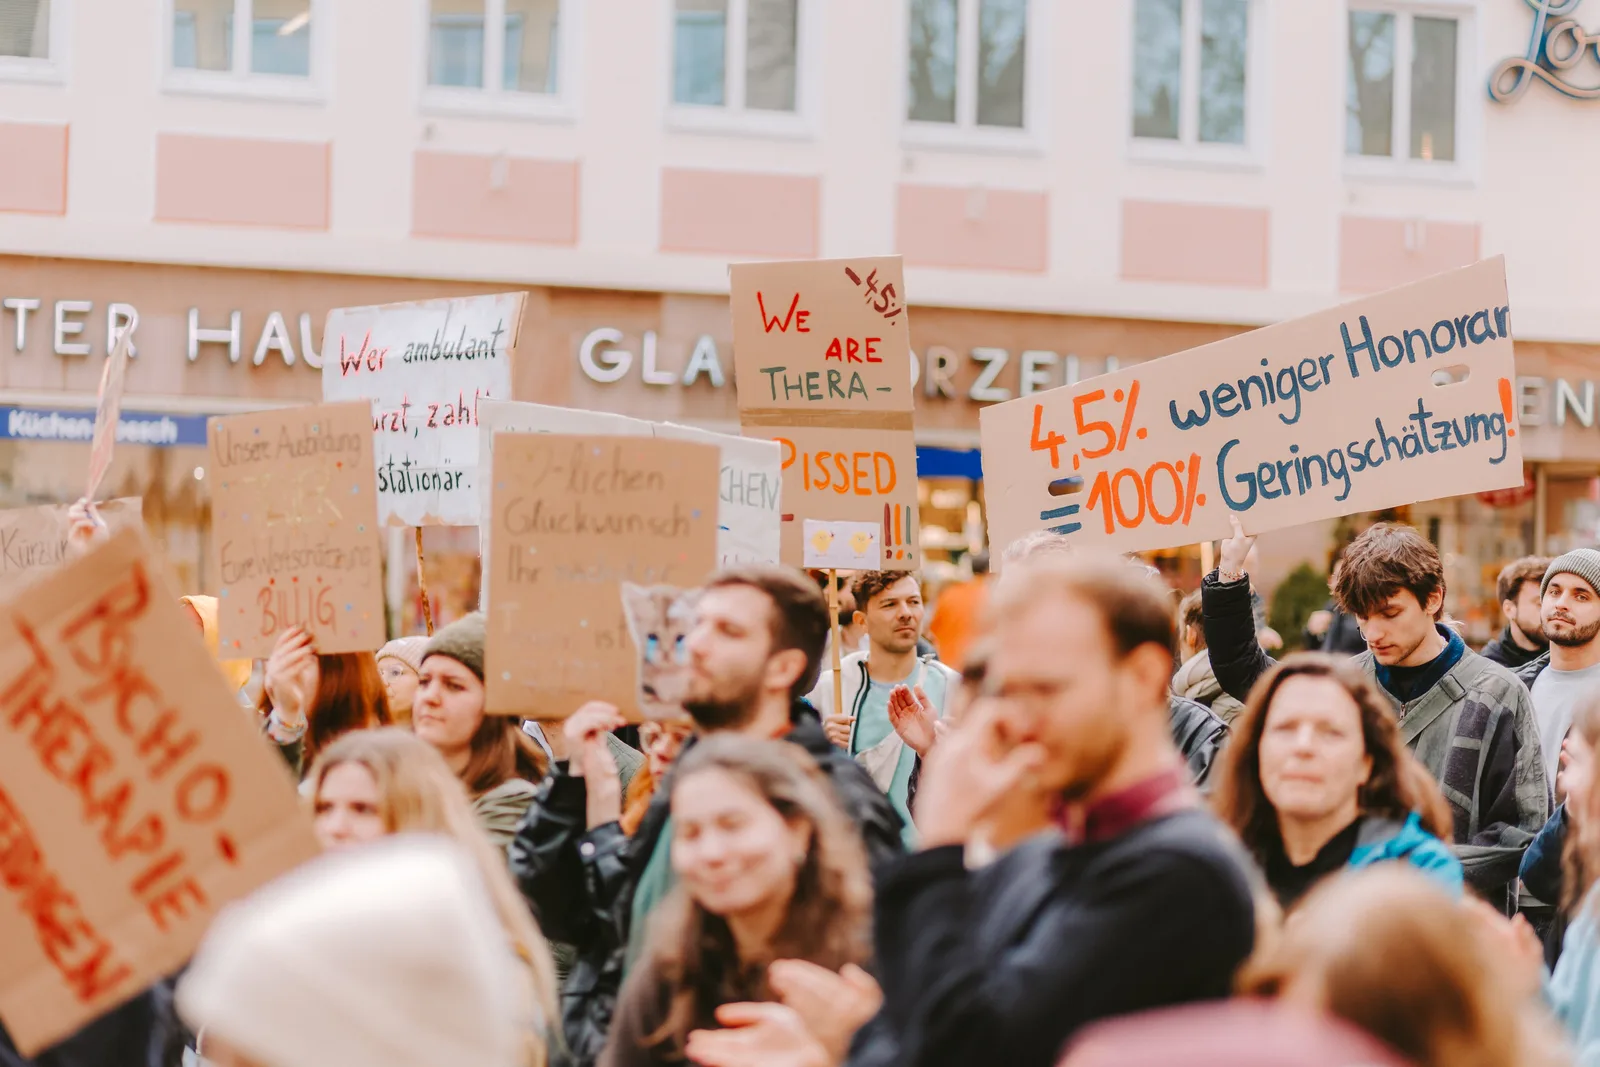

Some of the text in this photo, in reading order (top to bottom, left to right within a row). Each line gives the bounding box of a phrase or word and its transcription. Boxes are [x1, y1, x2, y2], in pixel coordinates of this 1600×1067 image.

[1486, 0, 1600, 103] Lo
[340, 318, 505, 376] Wer ambulant
[579, 326, 737, 389] GLA
[825, 337, 883, 364] ARE
[427, 387, 491, 428] zahl
[1030, 305, 1510, 470] 4,5% weniger Honorar
[378, 453, 471, 494] stationär.
[771, 437, 897, 497] PISSED
[1217, 377, 1516, 512] Geringschätzung!
